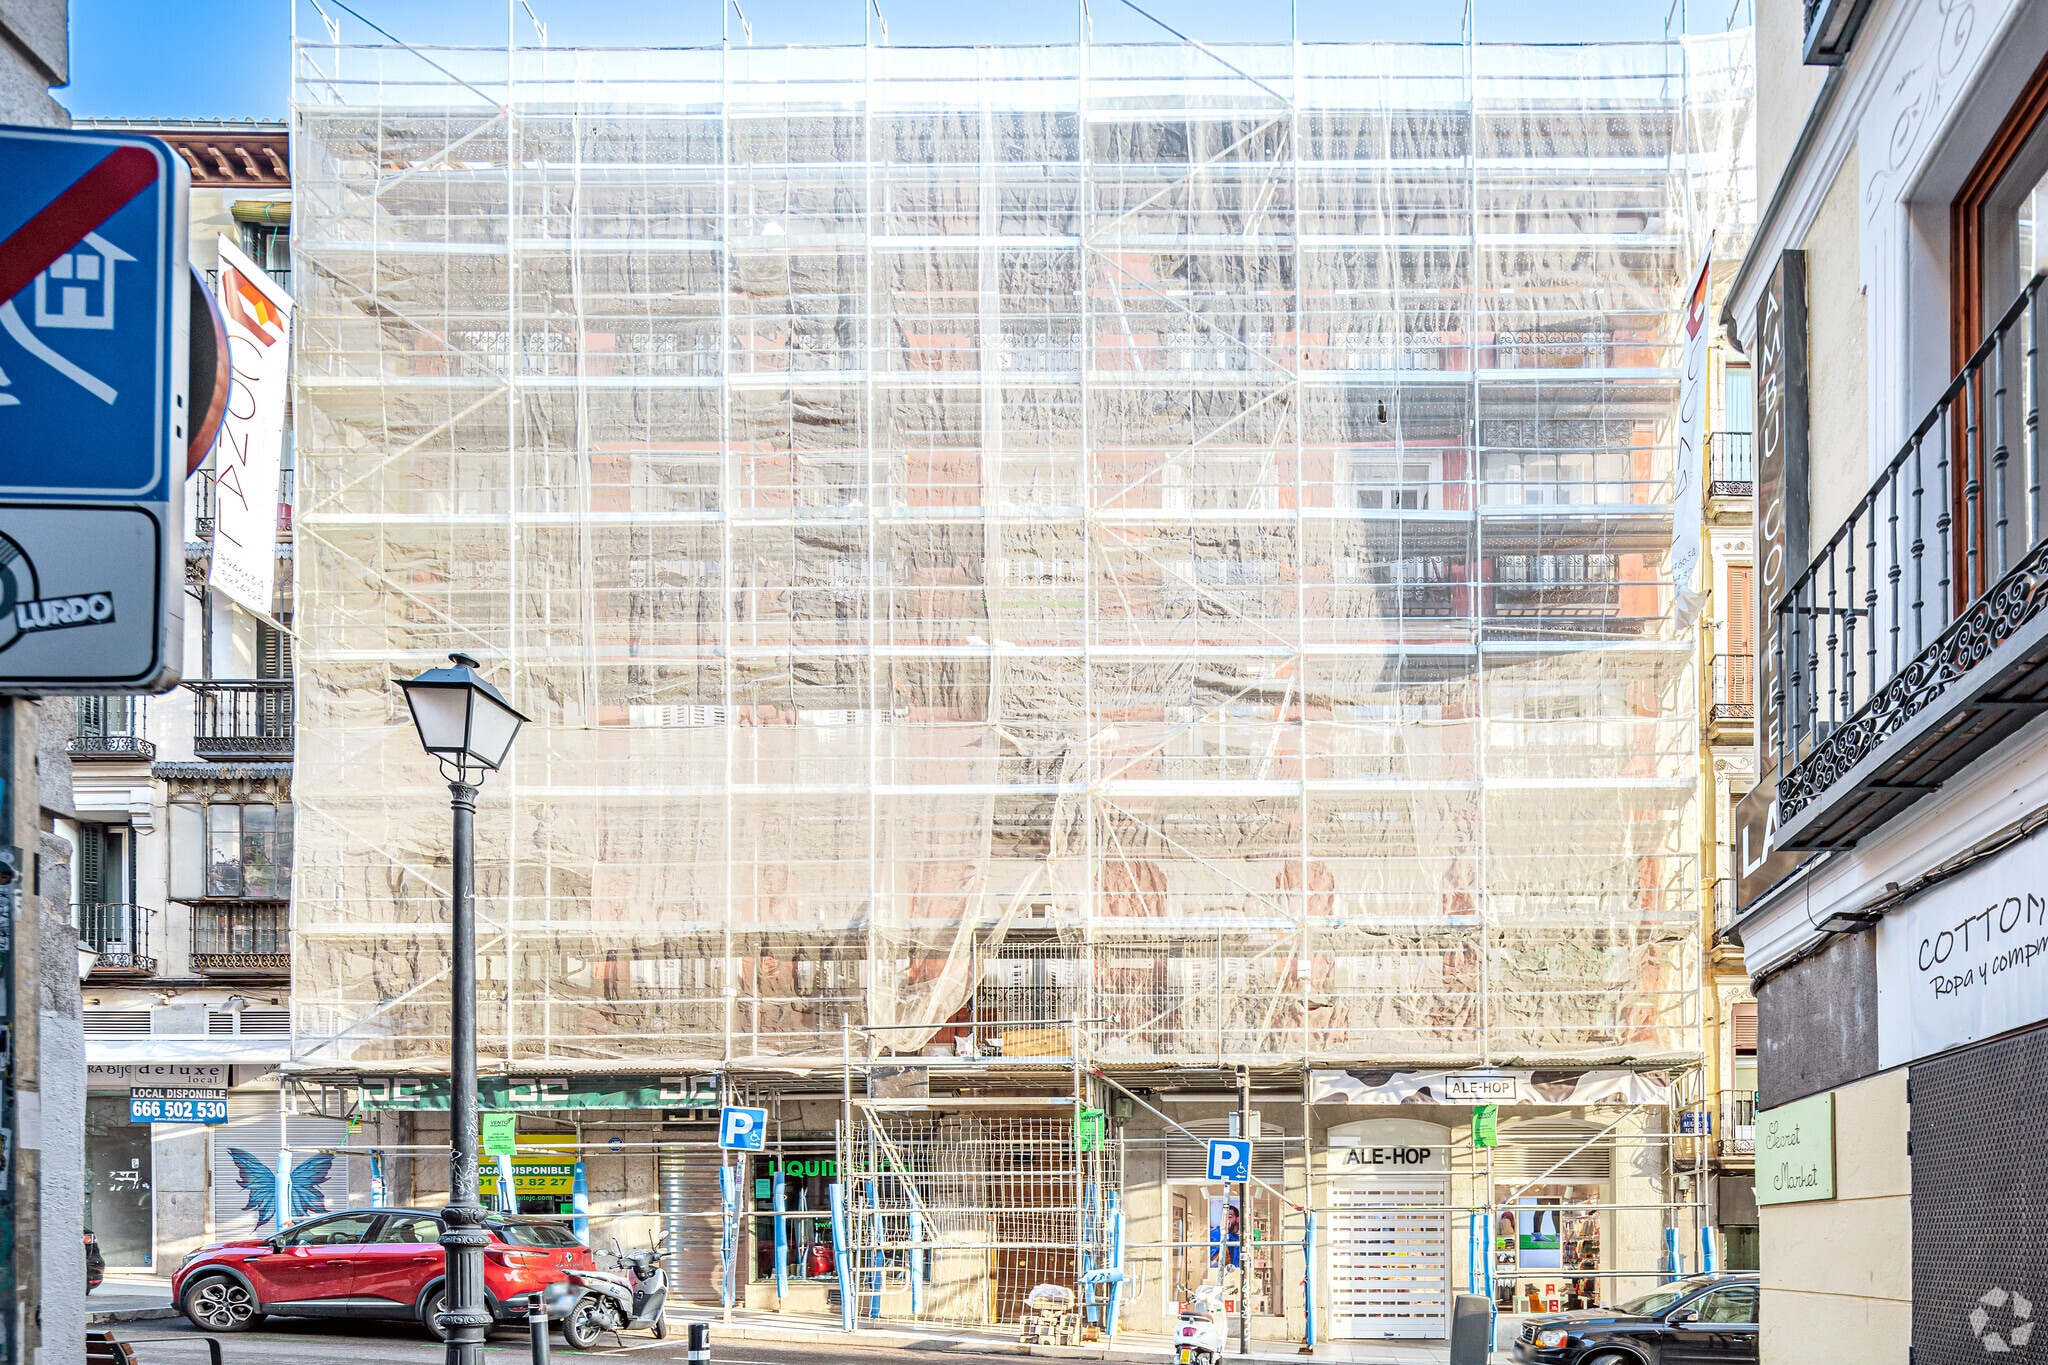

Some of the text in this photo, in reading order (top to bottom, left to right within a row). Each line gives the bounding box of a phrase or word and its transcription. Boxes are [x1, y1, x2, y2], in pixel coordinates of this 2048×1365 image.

[1918, 893, 2045, 971] COTTON
[1929, 968, 1974, 999] Ropa
[138, 1064, 219, 1075] deluxe
[187, 1075, 218, 1084] local
[132, 1088, 226, 1100] LOCAL DISPONIBLE
[1452, 1081, 1510, 1094] ALE-HOP
[132, 1101, 226, 1118] 666 502 530
[1346, 1148, 1431, 1164] ALE-HOP
[528, 1178, 546, 1186] 82
[550, 1178, 567, 1186] 27
[1773, 1161, 1818, 1190] Market
